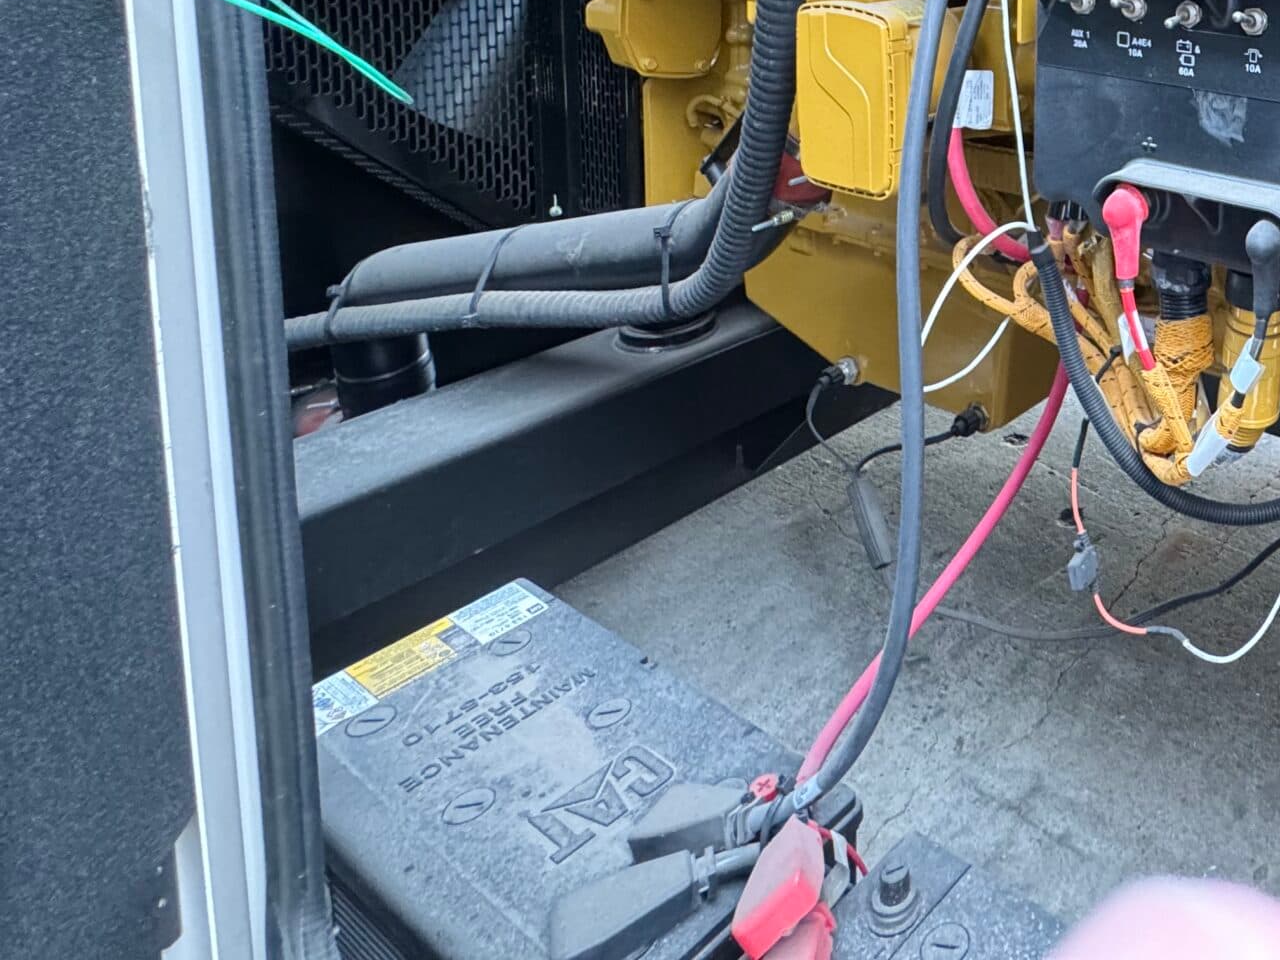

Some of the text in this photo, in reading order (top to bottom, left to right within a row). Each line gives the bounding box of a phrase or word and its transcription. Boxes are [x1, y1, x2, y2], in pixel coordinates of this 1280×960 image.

[1128, 48, 1143, 58] 10A
[1131, 37, 1152, 48] A4E4
[1244, 63, 1261, 74] 10A
[398, 667, 596, 792] MAINTENANCE
[452, 690, 528, 740] FREE
[527, 744, 676, 865] CAT
